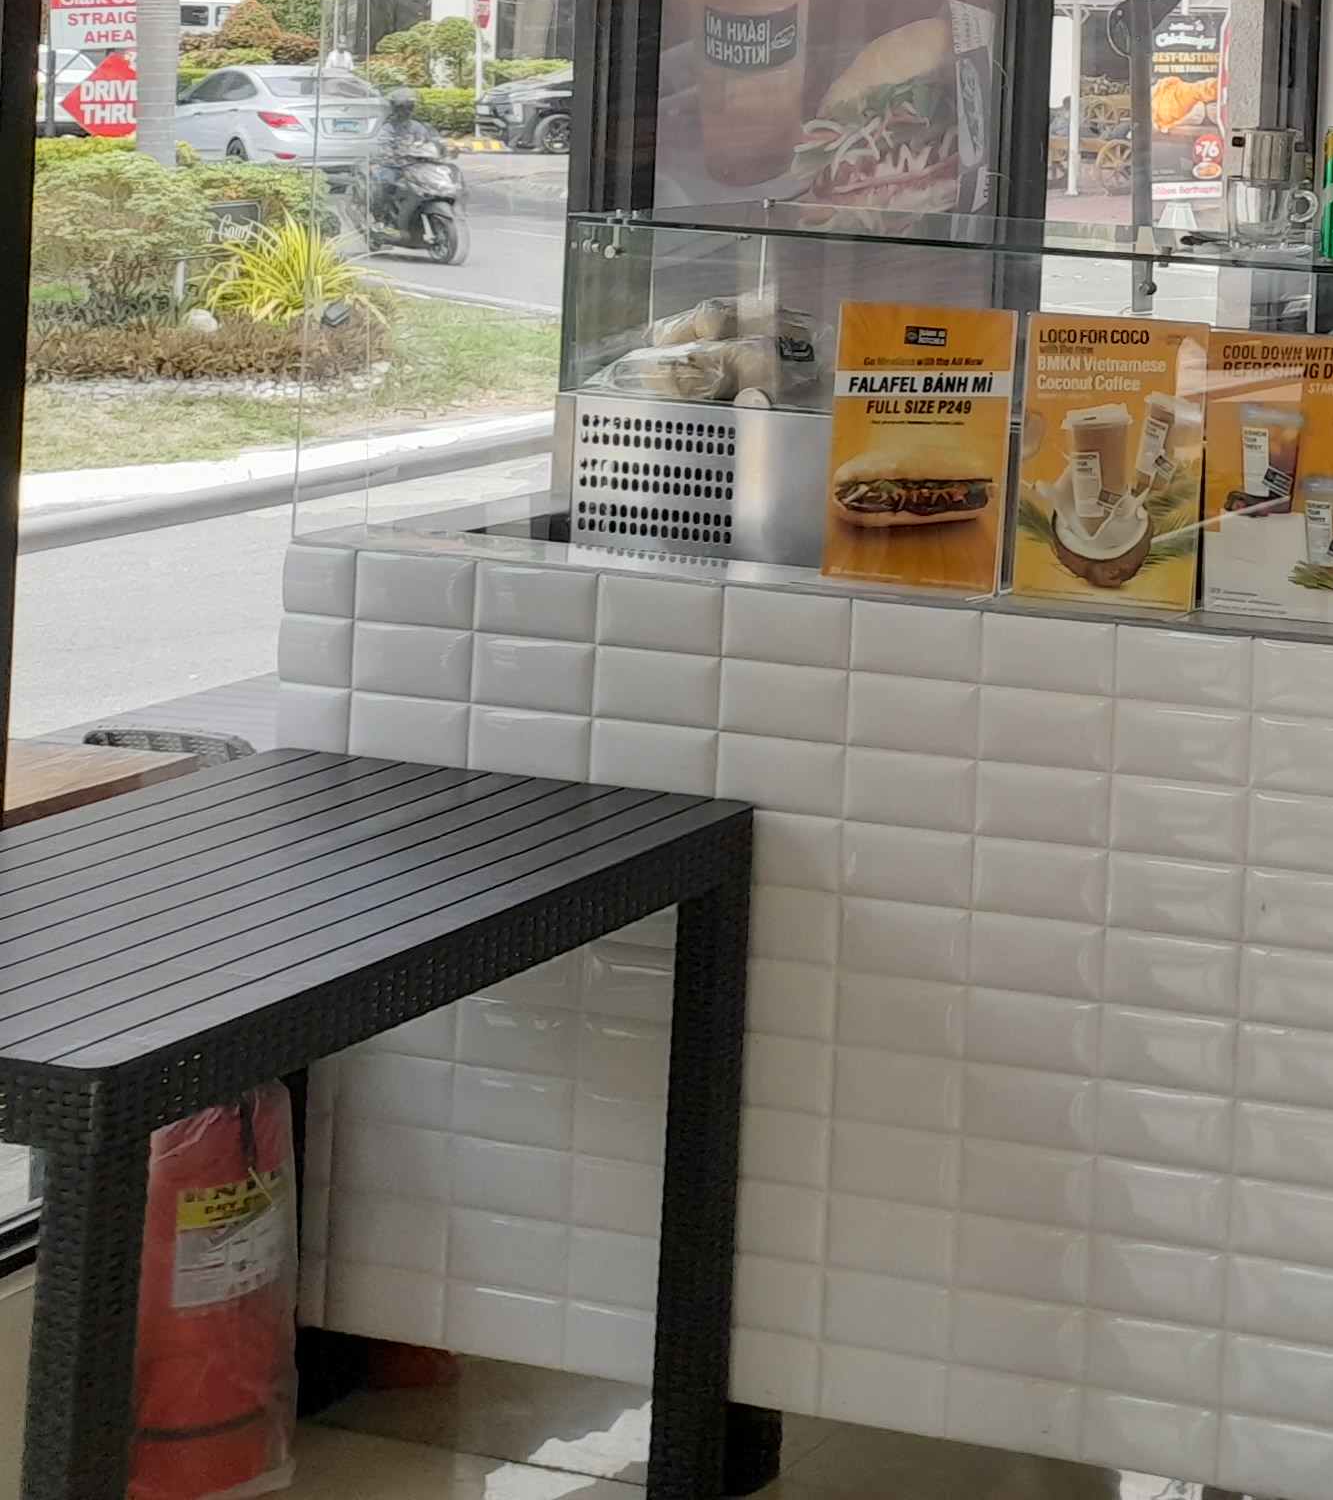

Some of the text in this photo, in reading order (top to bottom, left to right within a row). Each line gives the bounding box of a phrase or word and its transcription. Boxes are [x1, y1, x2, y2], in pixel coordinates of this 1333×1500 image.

[84, 29, 136, 44] AHEA
[1039, 328, 1150, 345] LOCO FOR COCO
[1222, 345, 1258, 360] COOL
[1261, 345, 1302, 361] DOWN
[1037, 355, 1167, 373] BMKN Vietnamese
[849, 371, 994, 393] FALAFEL BÁNH MÌ
[1036, 373, 1141, 392] Coconut Coffee
[866, 400, 972, 415] FULL SIZE P249
